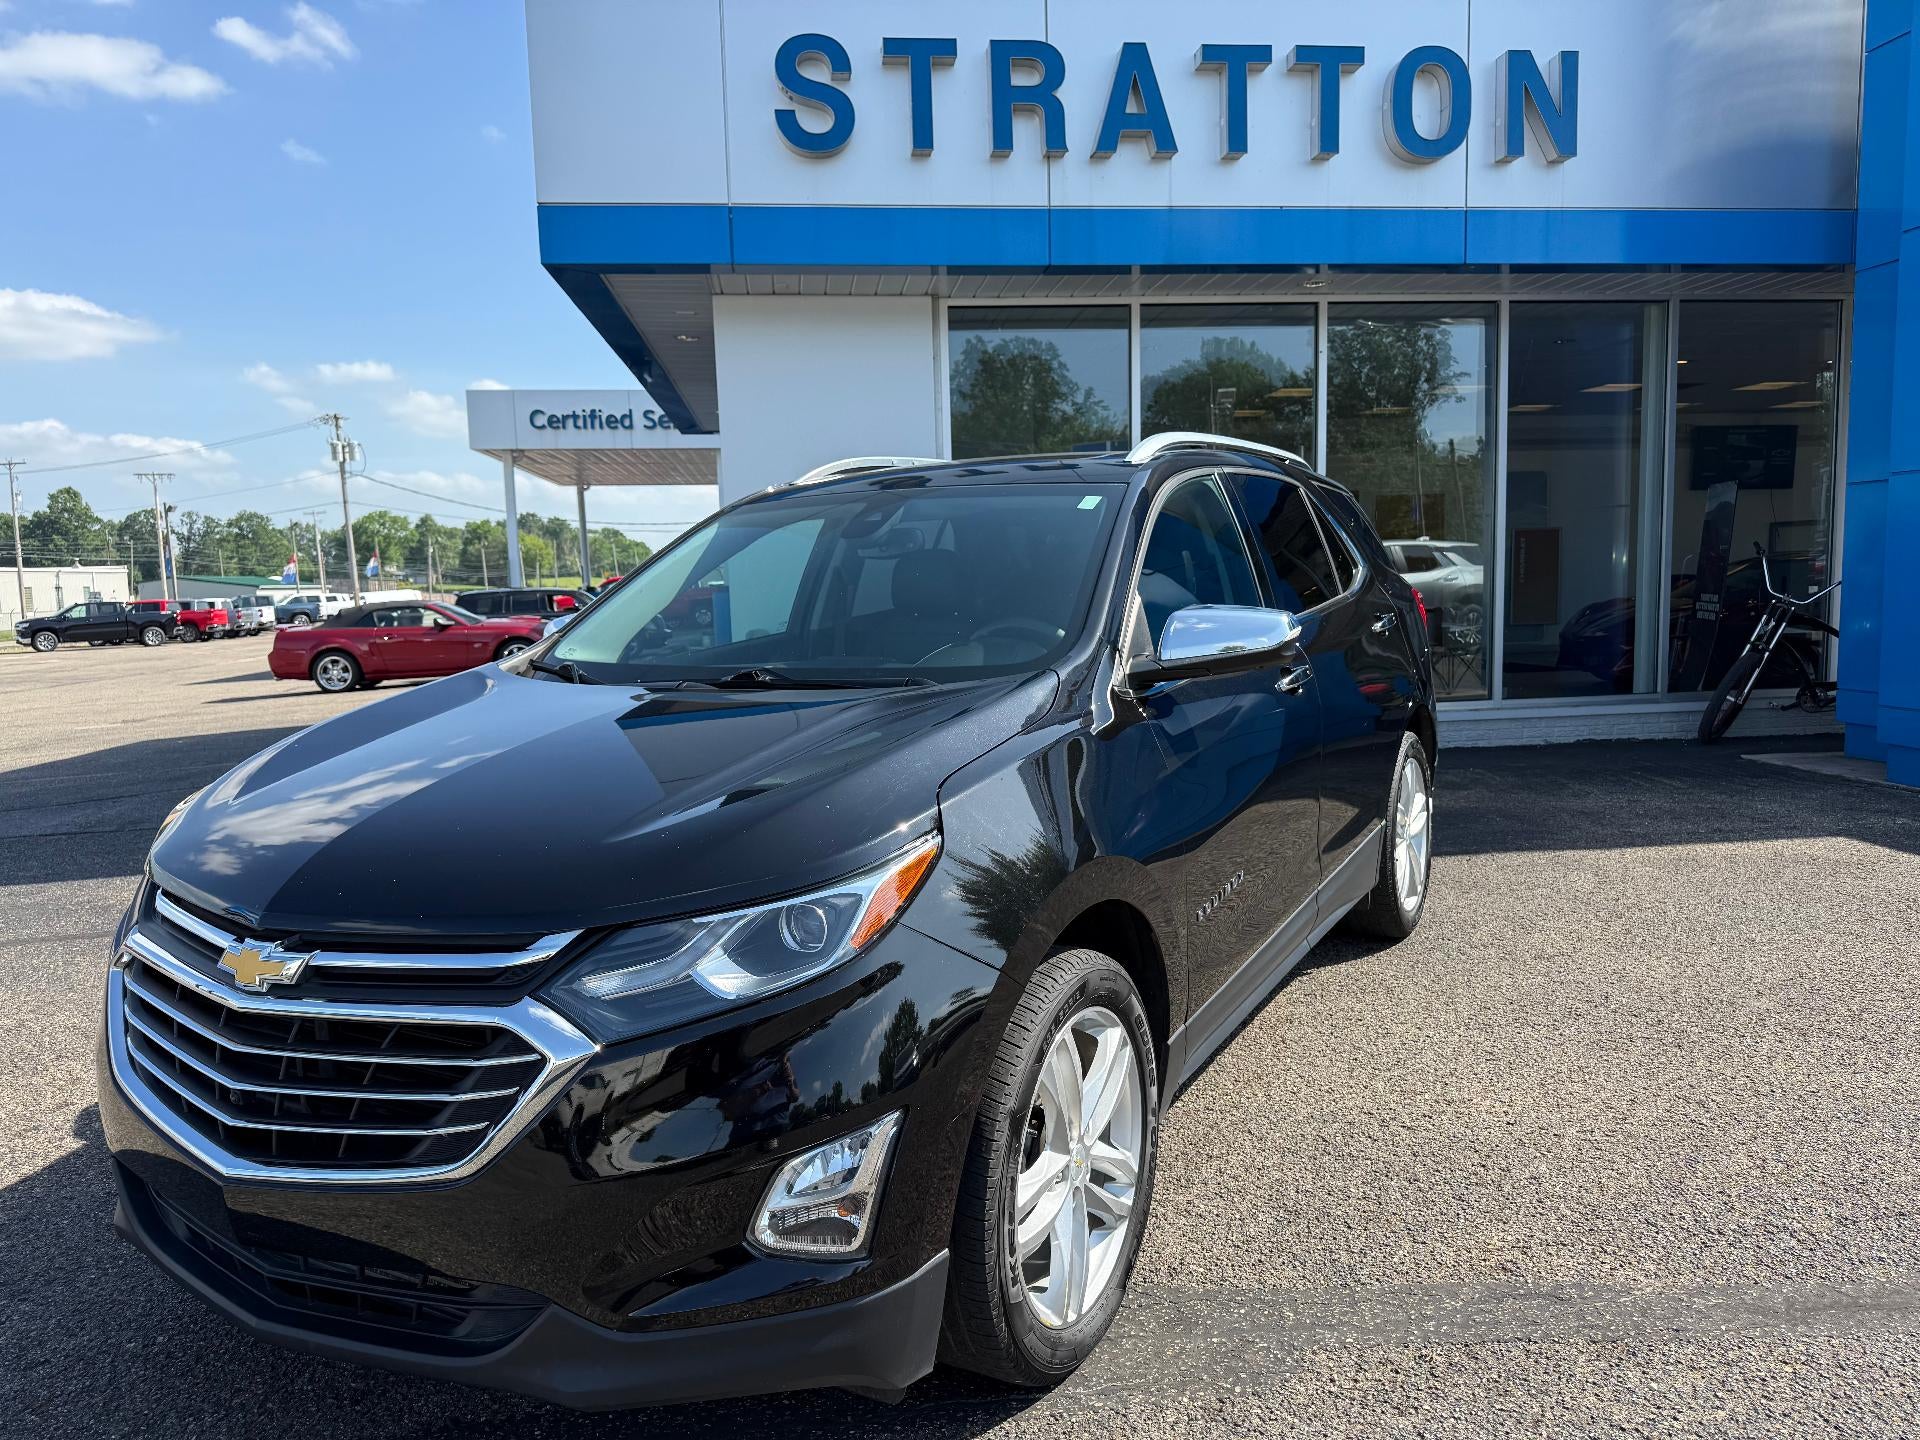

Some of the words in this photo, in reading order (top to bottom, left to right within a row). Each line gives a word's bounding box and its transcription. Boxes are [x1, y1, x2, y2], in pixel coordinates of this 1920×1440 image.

[774, 32, 1580, 164] STRATTON
[529, 409, 634, 430] Certified
[643, 409, 676, 430] Se
